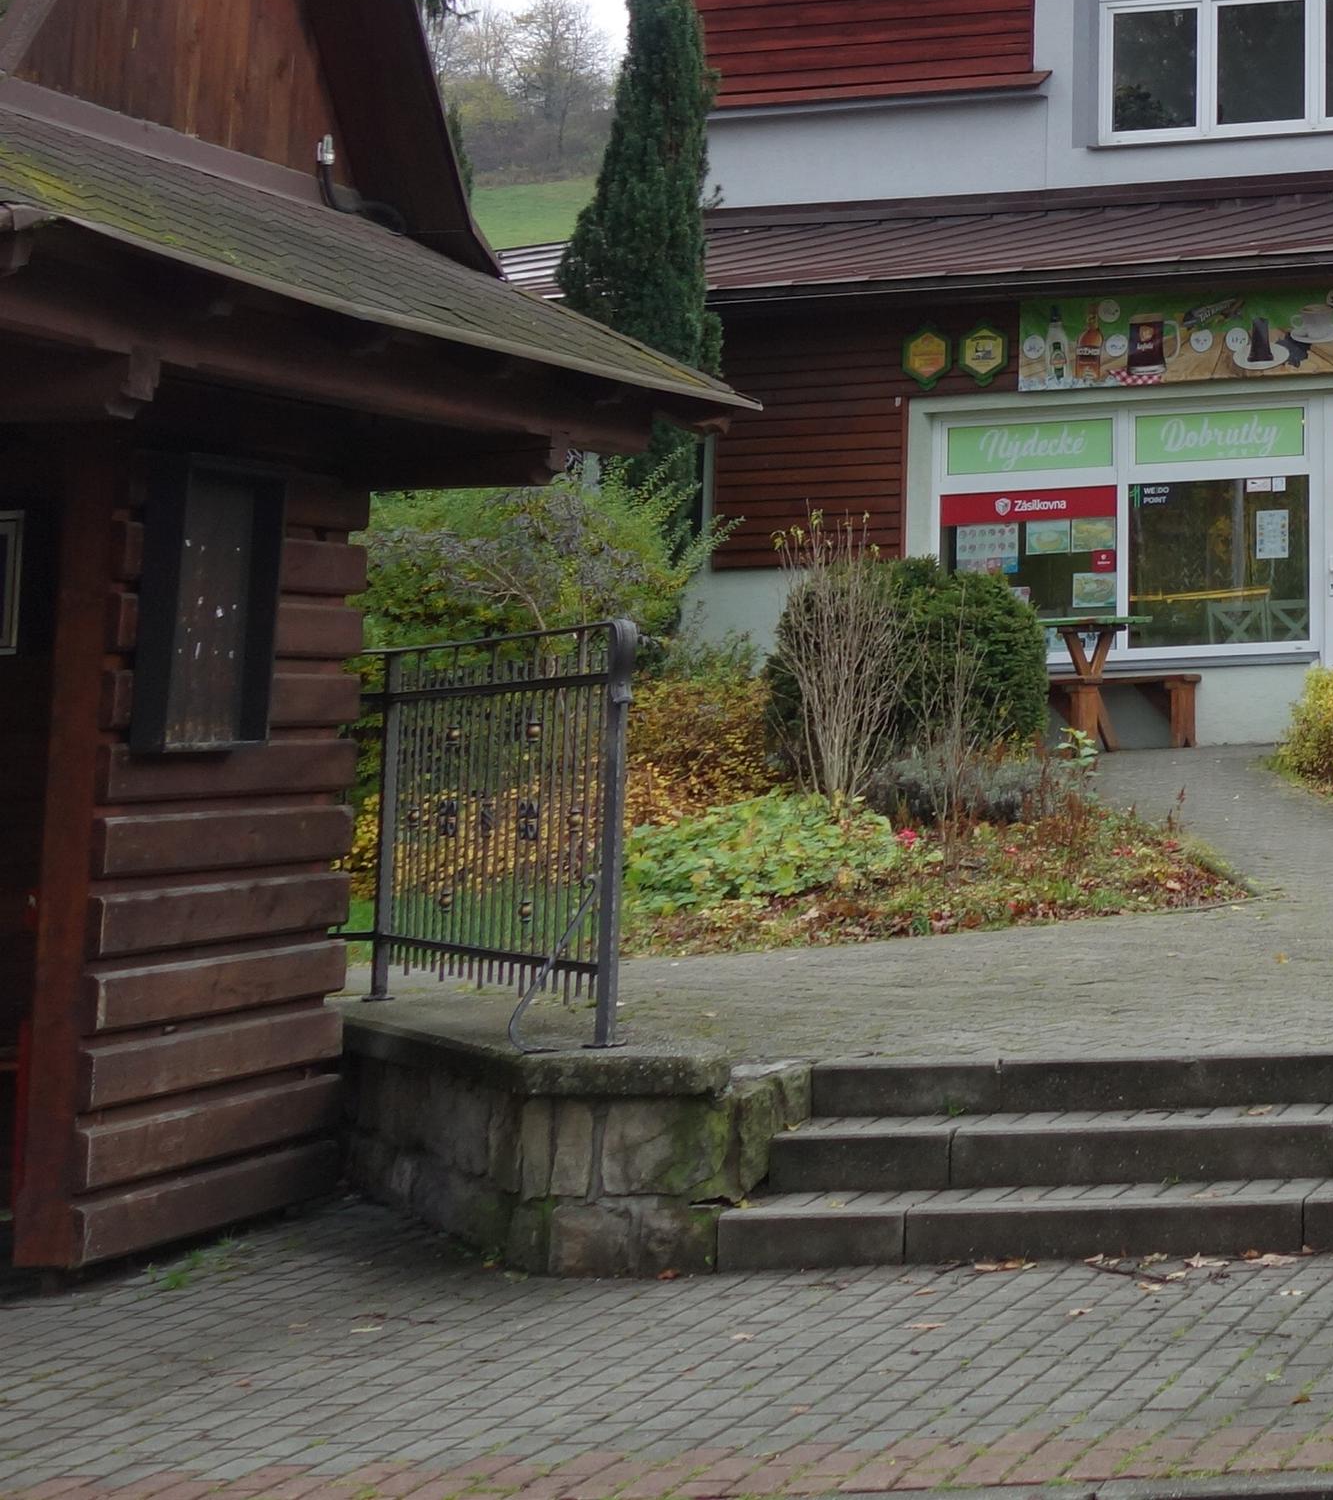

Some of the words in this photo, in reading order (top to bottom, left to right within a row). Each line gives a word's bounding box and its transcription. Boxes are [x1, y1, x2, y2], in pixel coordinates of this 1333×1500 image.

[979, 425, 1086, 470] Nýdecké
[1014, 498, 1067, 512] Zásilkovna
[1143, 496, 1168, 504] POINT
